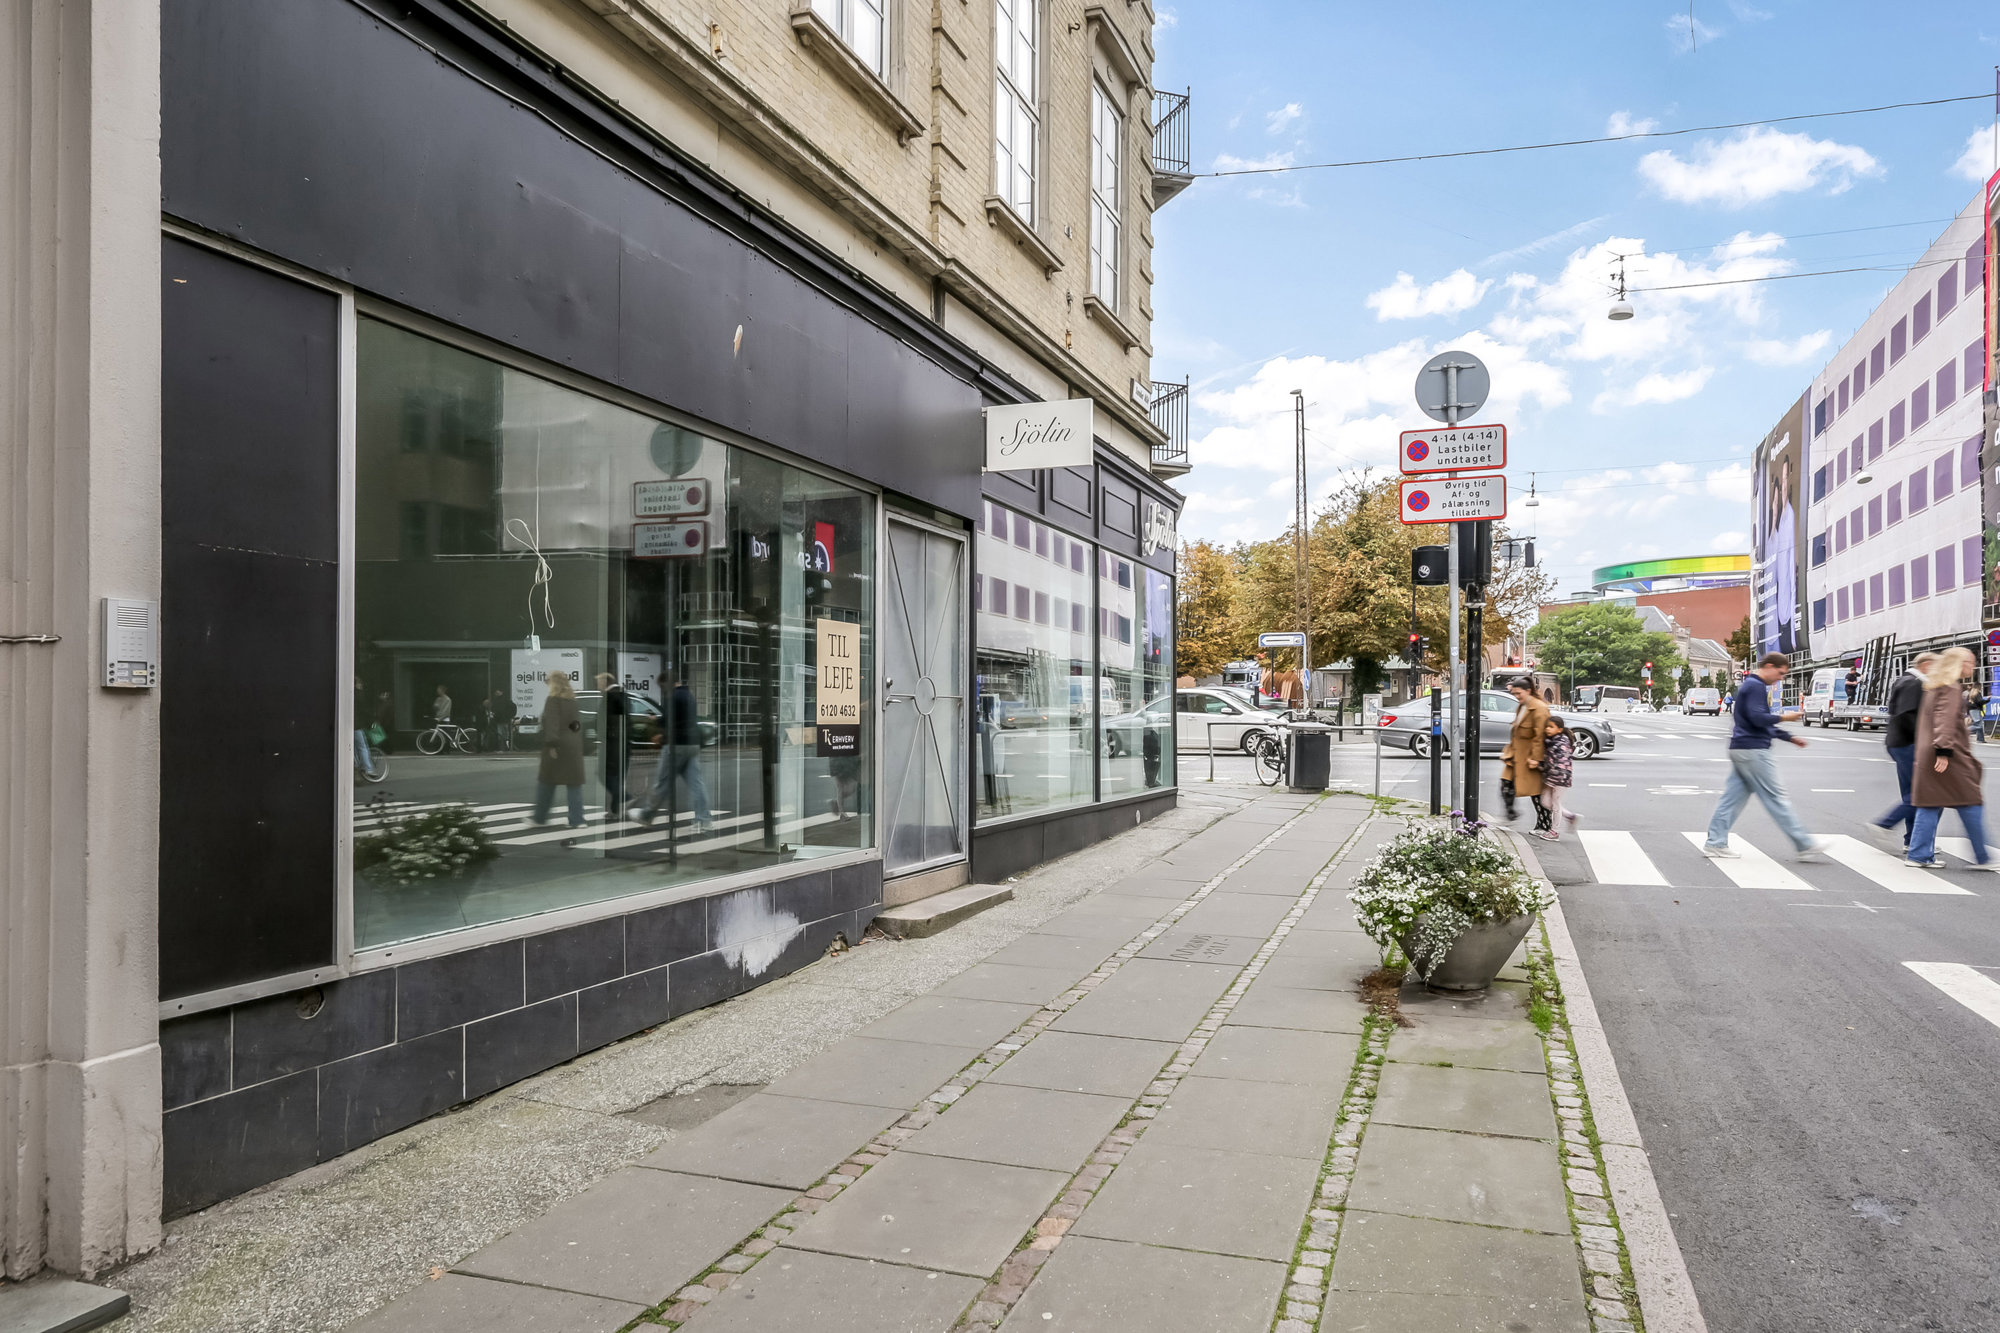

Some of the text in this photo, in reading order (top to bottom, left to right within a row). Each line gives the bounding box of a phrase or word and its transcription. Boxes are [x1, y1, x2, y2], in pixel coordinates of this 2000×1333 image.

[1000, 416, 1077, 457] Sjölin
[1438, 444, 1491, 454] Lastbiler
[1437, 454, 1492, 465] undtaget
[1445, 479, 1487, 490] Øvrig tid
[1451, 490, 1480, 499] Af- og
[1442, 499, 1490, 509] pålæsning
[1451, 508, 1481, 517] tilladt
[827, 633, 850, 659] TIL
[824, 665, 854, 694] LEJE
[820, 704, 856, 717] 6120 4632
[832, 735, 855, 744] ERHVERV
